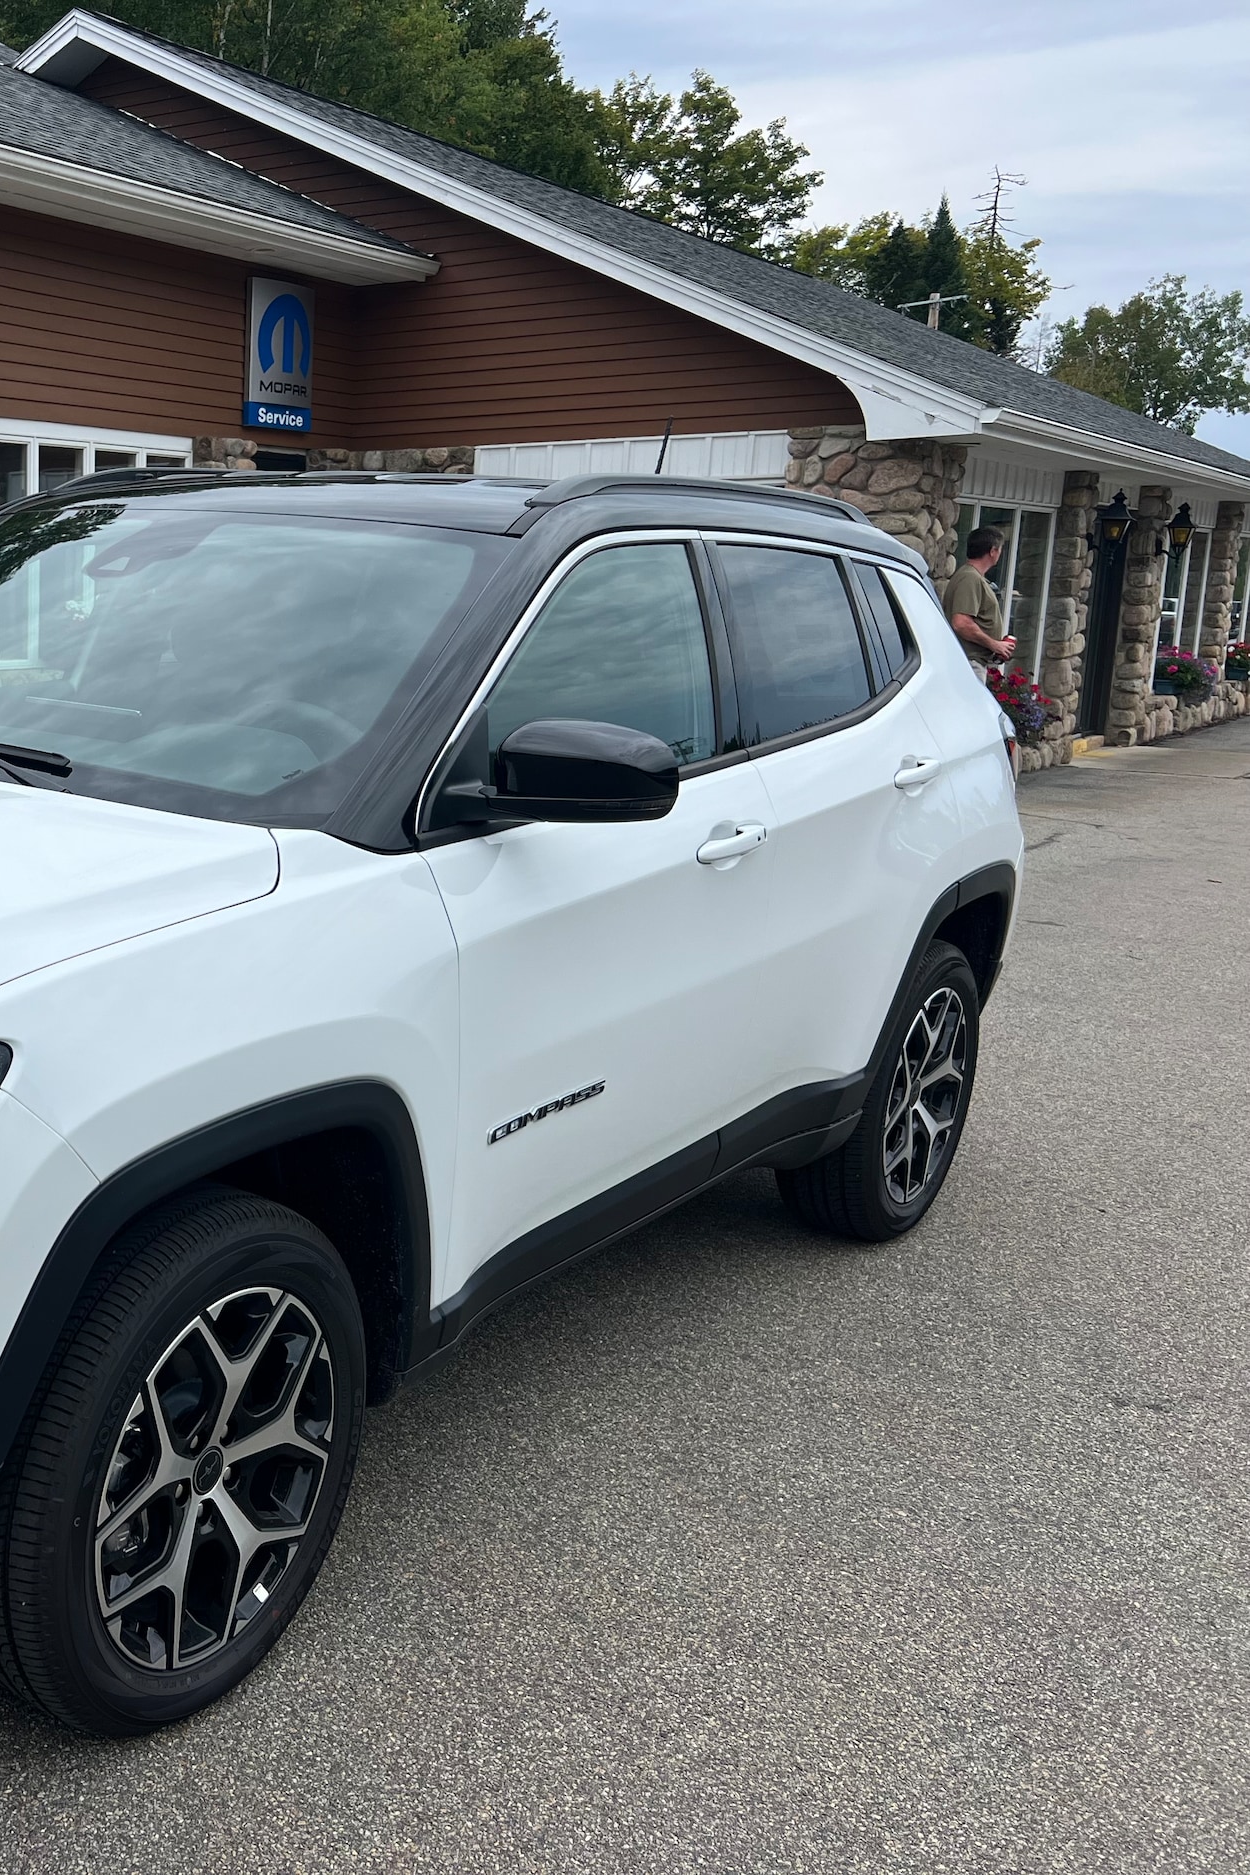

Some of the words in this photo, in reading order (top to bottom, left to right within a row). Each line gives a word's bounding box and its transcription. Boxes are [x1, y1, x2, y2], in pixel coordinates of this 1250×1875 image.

[259, 379, 307, 398] MOPAR
[257, 406, 304, 428] Service
[486, 1078, 606, 1146] COMPASS
[92, 1338, 158, 1460] YOKOHAMA
